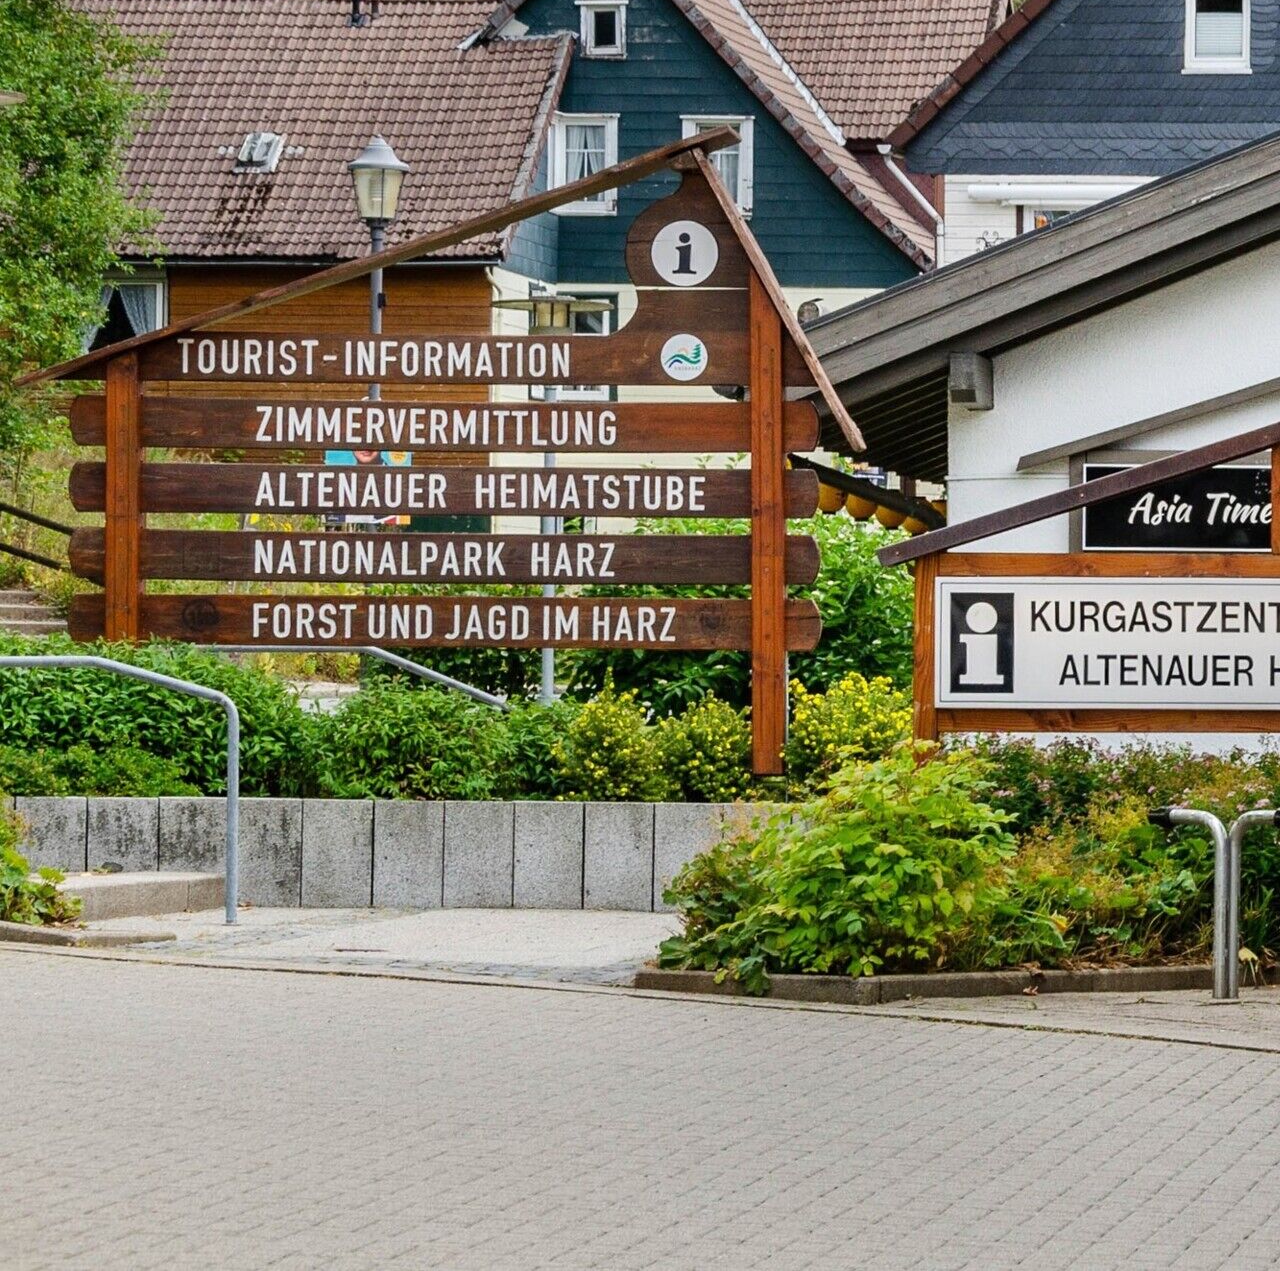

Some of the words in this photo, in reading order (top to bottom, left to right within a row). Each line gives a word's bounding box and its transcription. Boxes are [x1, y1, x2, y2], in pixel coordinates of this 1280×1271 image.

[177, 337, 571, 378] TOURIST-INFORMATION
[255, 405, 618, 446] ZIMMERVERMITTLUNG
[254, 471, 447, 509] ALTENAUER
[475, 473, 706, 512] HEIMATSTUBE
[1128, 492, 1193, 526] Asia
[1206, 491, 1273, 526] Time
[254, 539, 506, 576] NATIONALPARK
[530, 542, 615, 577] HARZ
[252, 602, 357, 639] FORST
[368, 604, 433, 640] UND
[444, 604, 530, 641] JAGD
[542, 605, 579, 641] IM
[592, 605, 676, 642] HARZ
[1058, 654, 1254, 687] ALTENAUER
